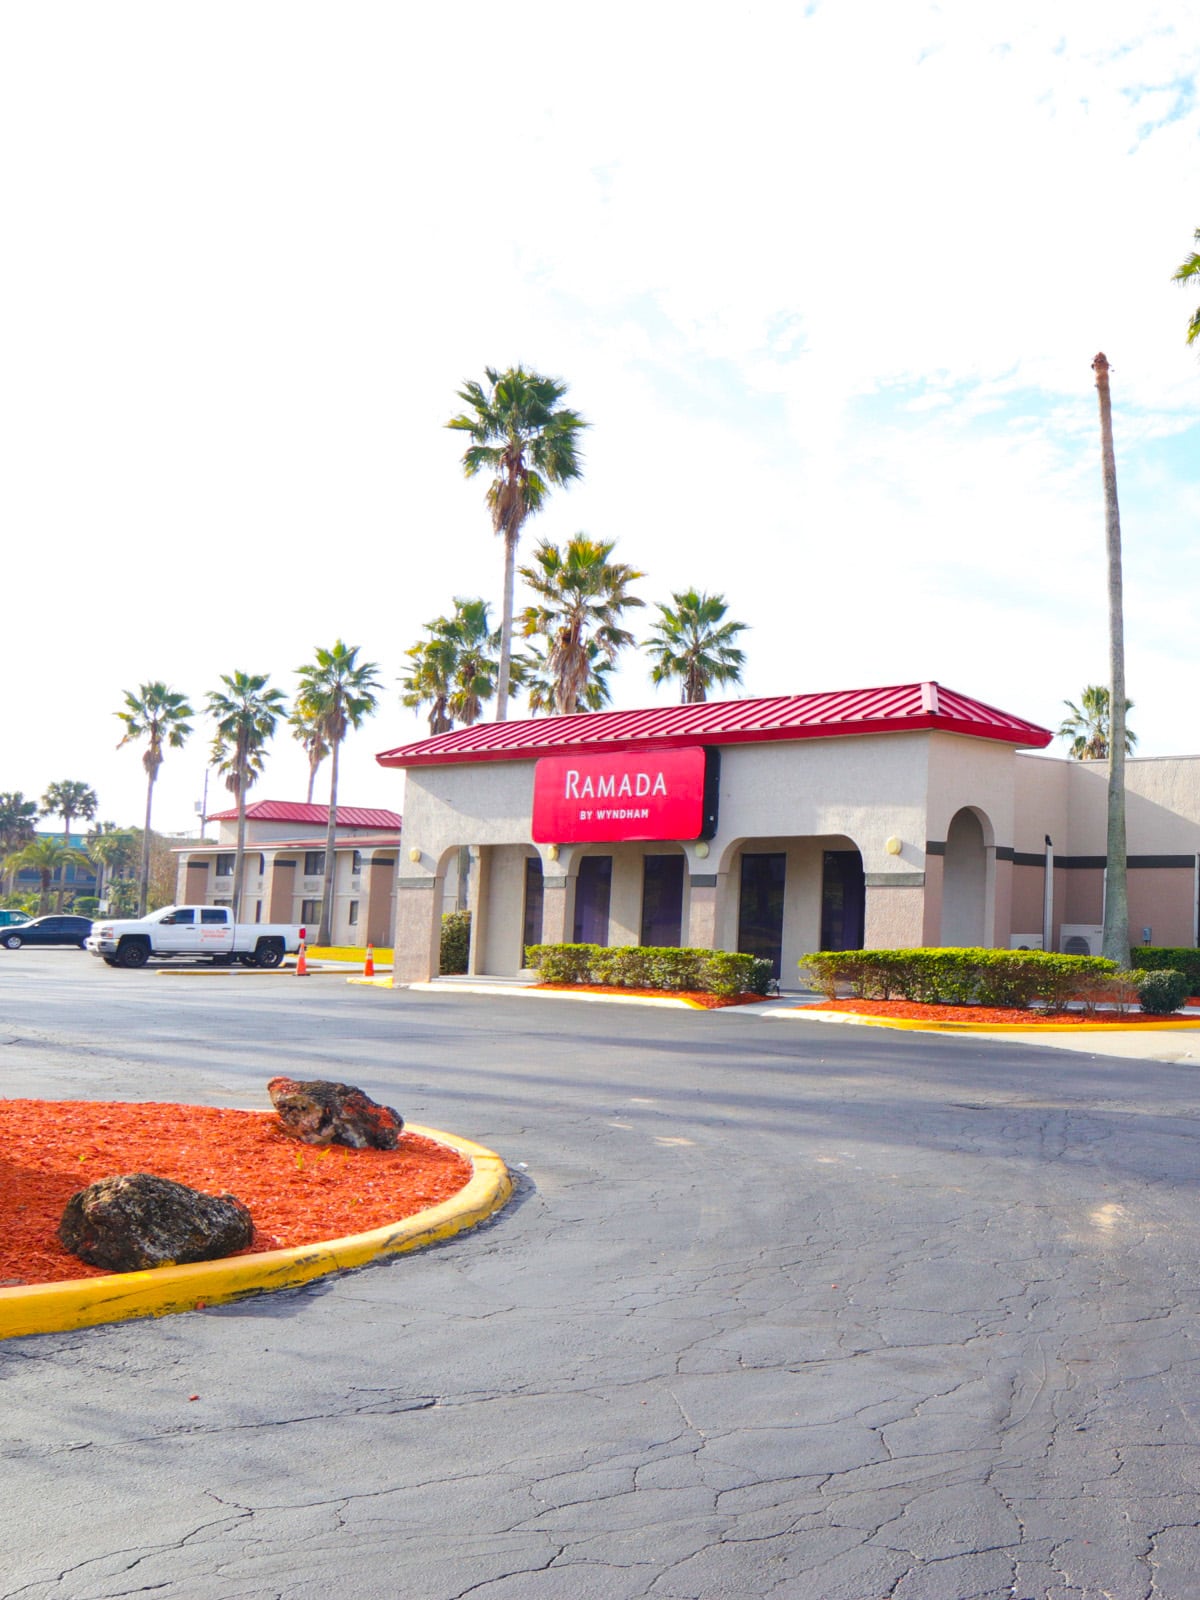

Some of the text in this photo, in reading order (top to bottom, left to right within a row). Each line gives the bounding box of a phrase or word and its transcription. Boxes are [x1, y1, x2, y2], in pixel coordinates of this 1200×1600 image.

[565, 769, 668, 800] RAMADA
[580, 808, 650, 821] BY WYNDHAM
